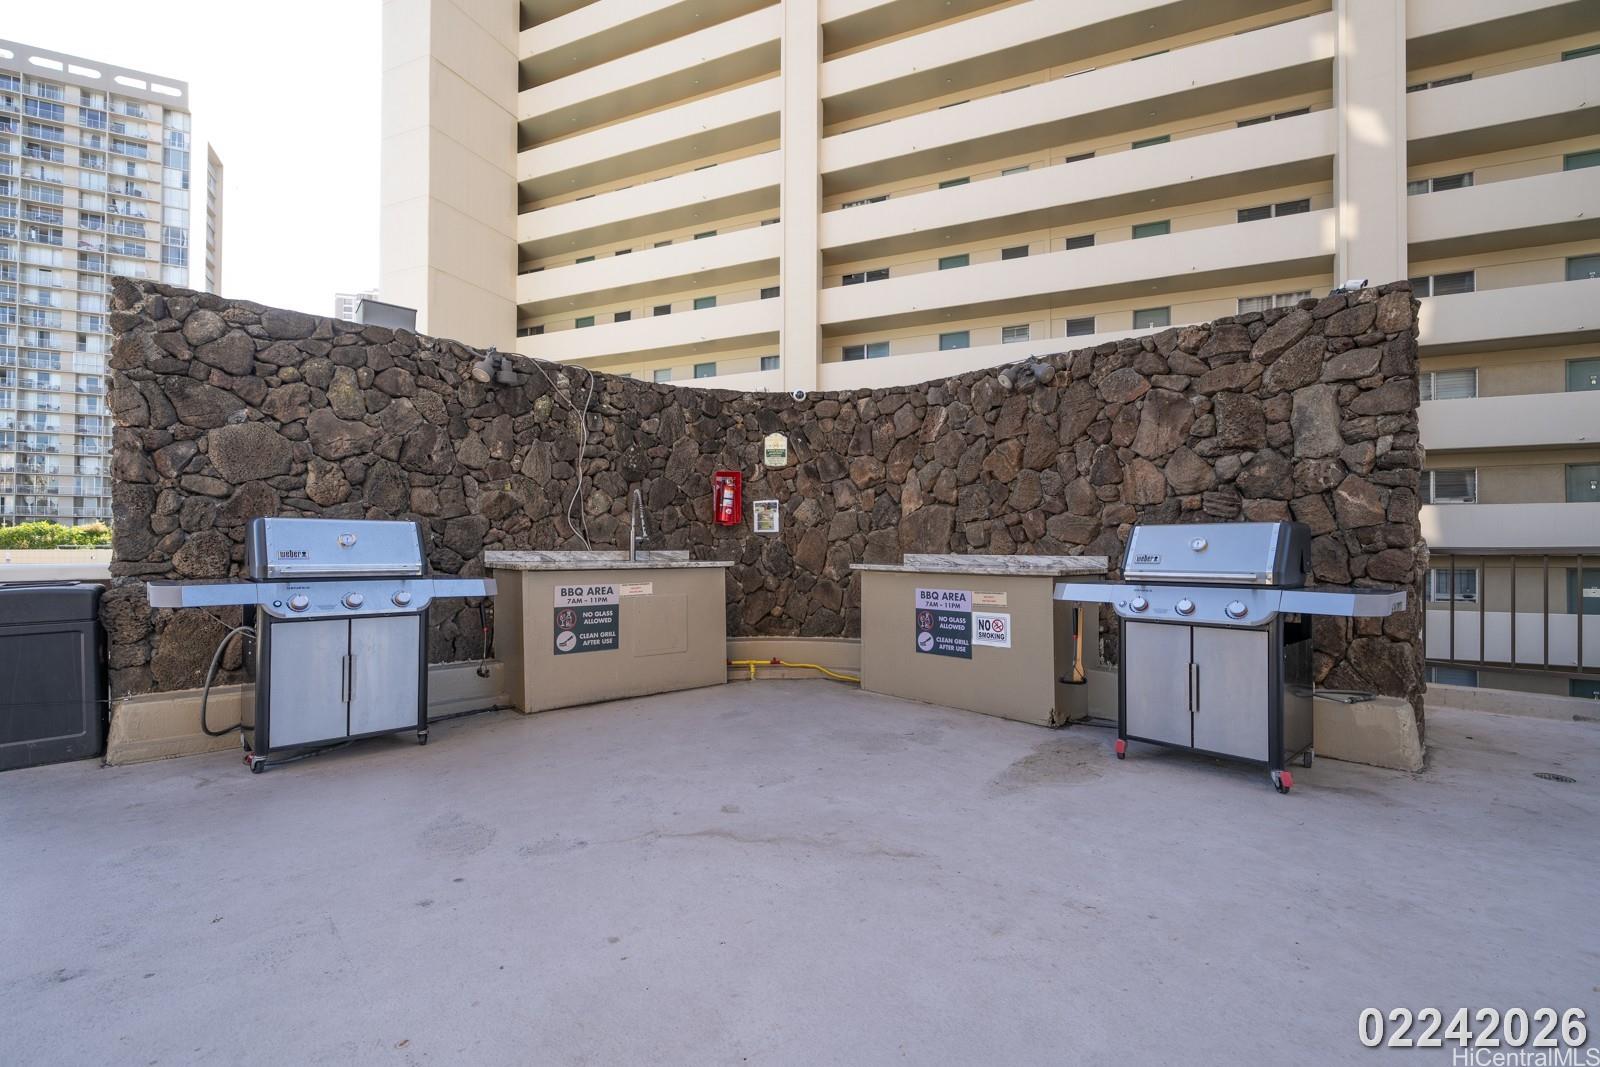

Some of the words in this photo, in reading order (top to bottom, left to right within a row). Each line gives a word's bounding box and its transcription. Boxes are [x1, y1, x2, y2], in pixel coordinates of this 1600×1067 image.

[280, 550, 301, 558] weber
[560, 587, 584, 597] BBQ
[586, 586, 614, 596] AREA
[920, 590, 939, 600] BBQ
[941, 592, 967, 602] AREA
[583, 617, 613, 625] ALLOWED
[978, 619, 991, 631] NO
[939, 623, 966, 631] ALLOWED
[579, 632, 599, 640] CLEAN
[978, 631, 1005, 641] SMOKING
[935, 636, 953, 644] CLEAN
[954, 638, 969, 646] GRILL
[955, 645, 966, 653] USE
